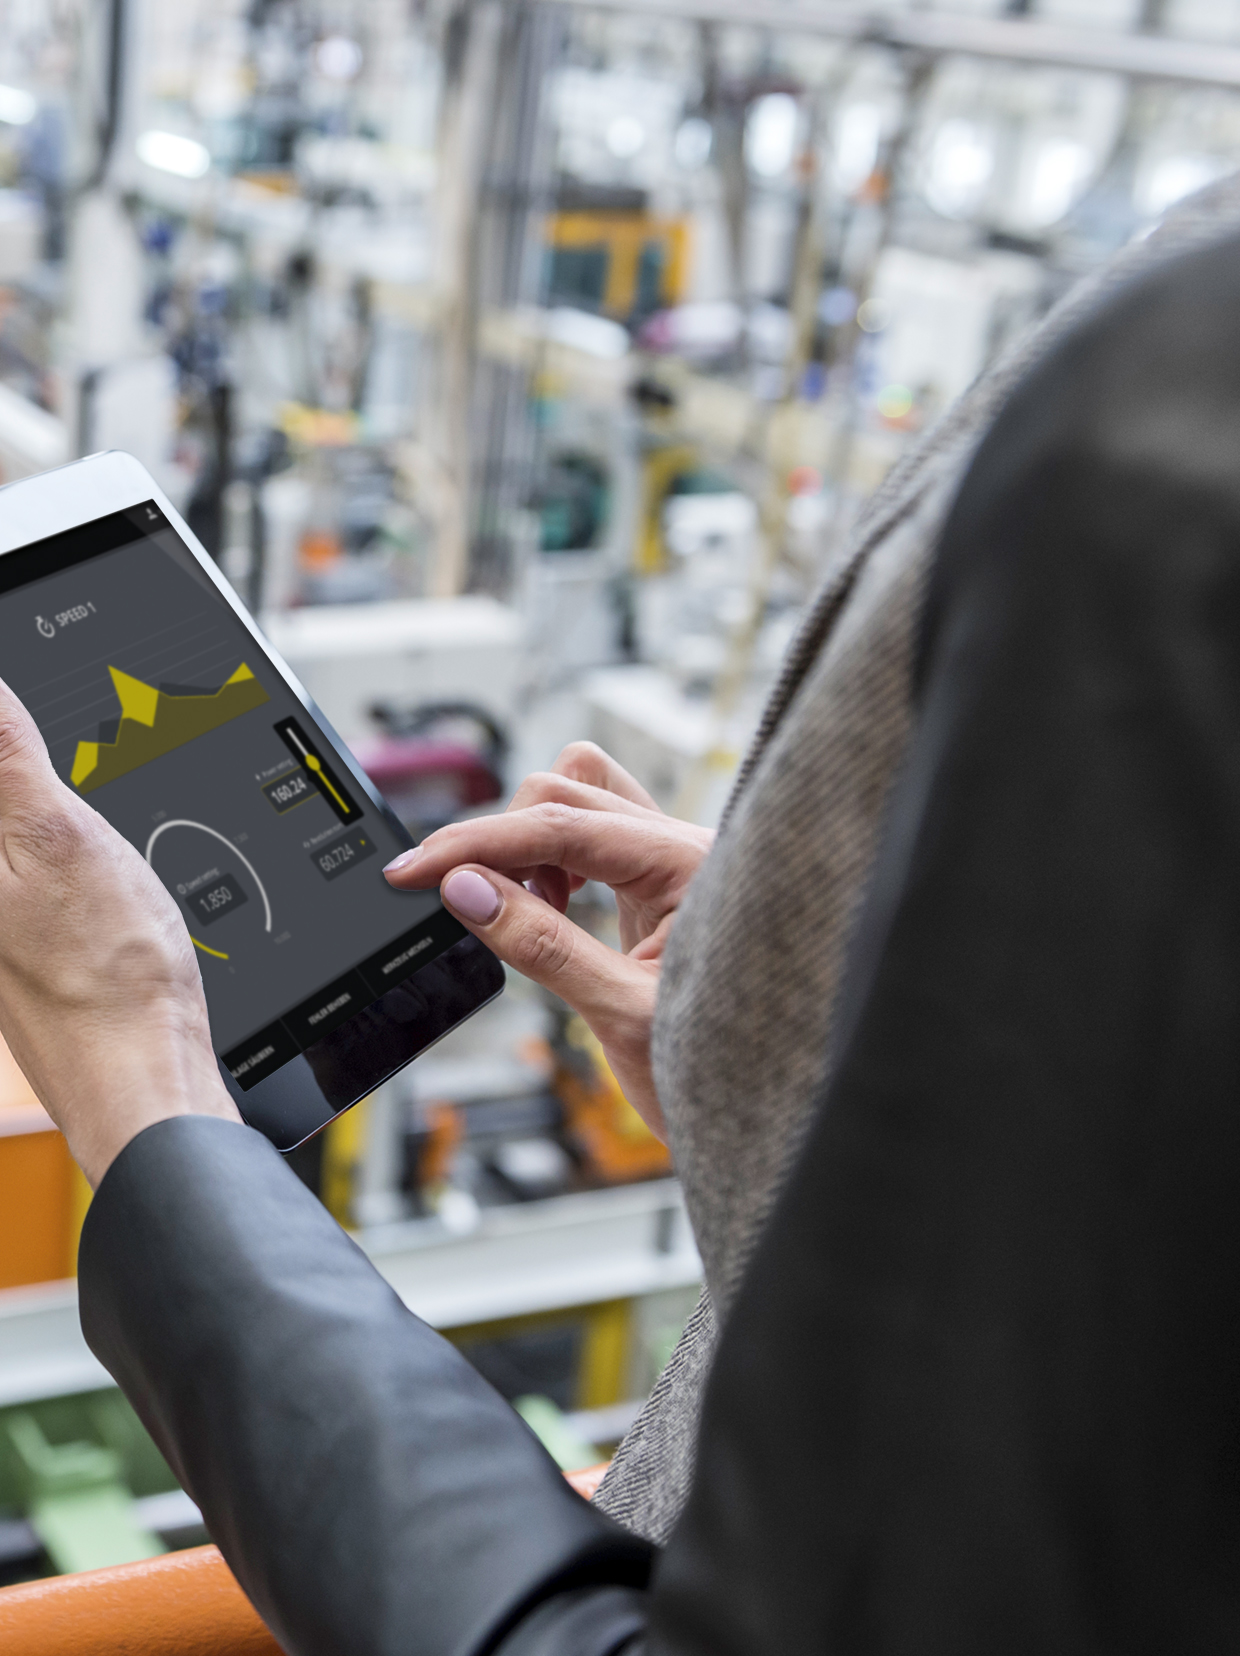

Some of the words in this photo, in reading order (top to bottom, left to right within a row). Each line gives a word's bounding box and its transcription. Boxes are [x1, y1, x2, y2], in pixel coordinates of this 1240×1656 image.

[55, 605, 88, 627] SPEED
[87, 601, 97, 613] 1
[271, 777, 307, 804] 160.24
[319, 843, 355, 872] 60.724
[199, 886, 232, 912] 1.850
